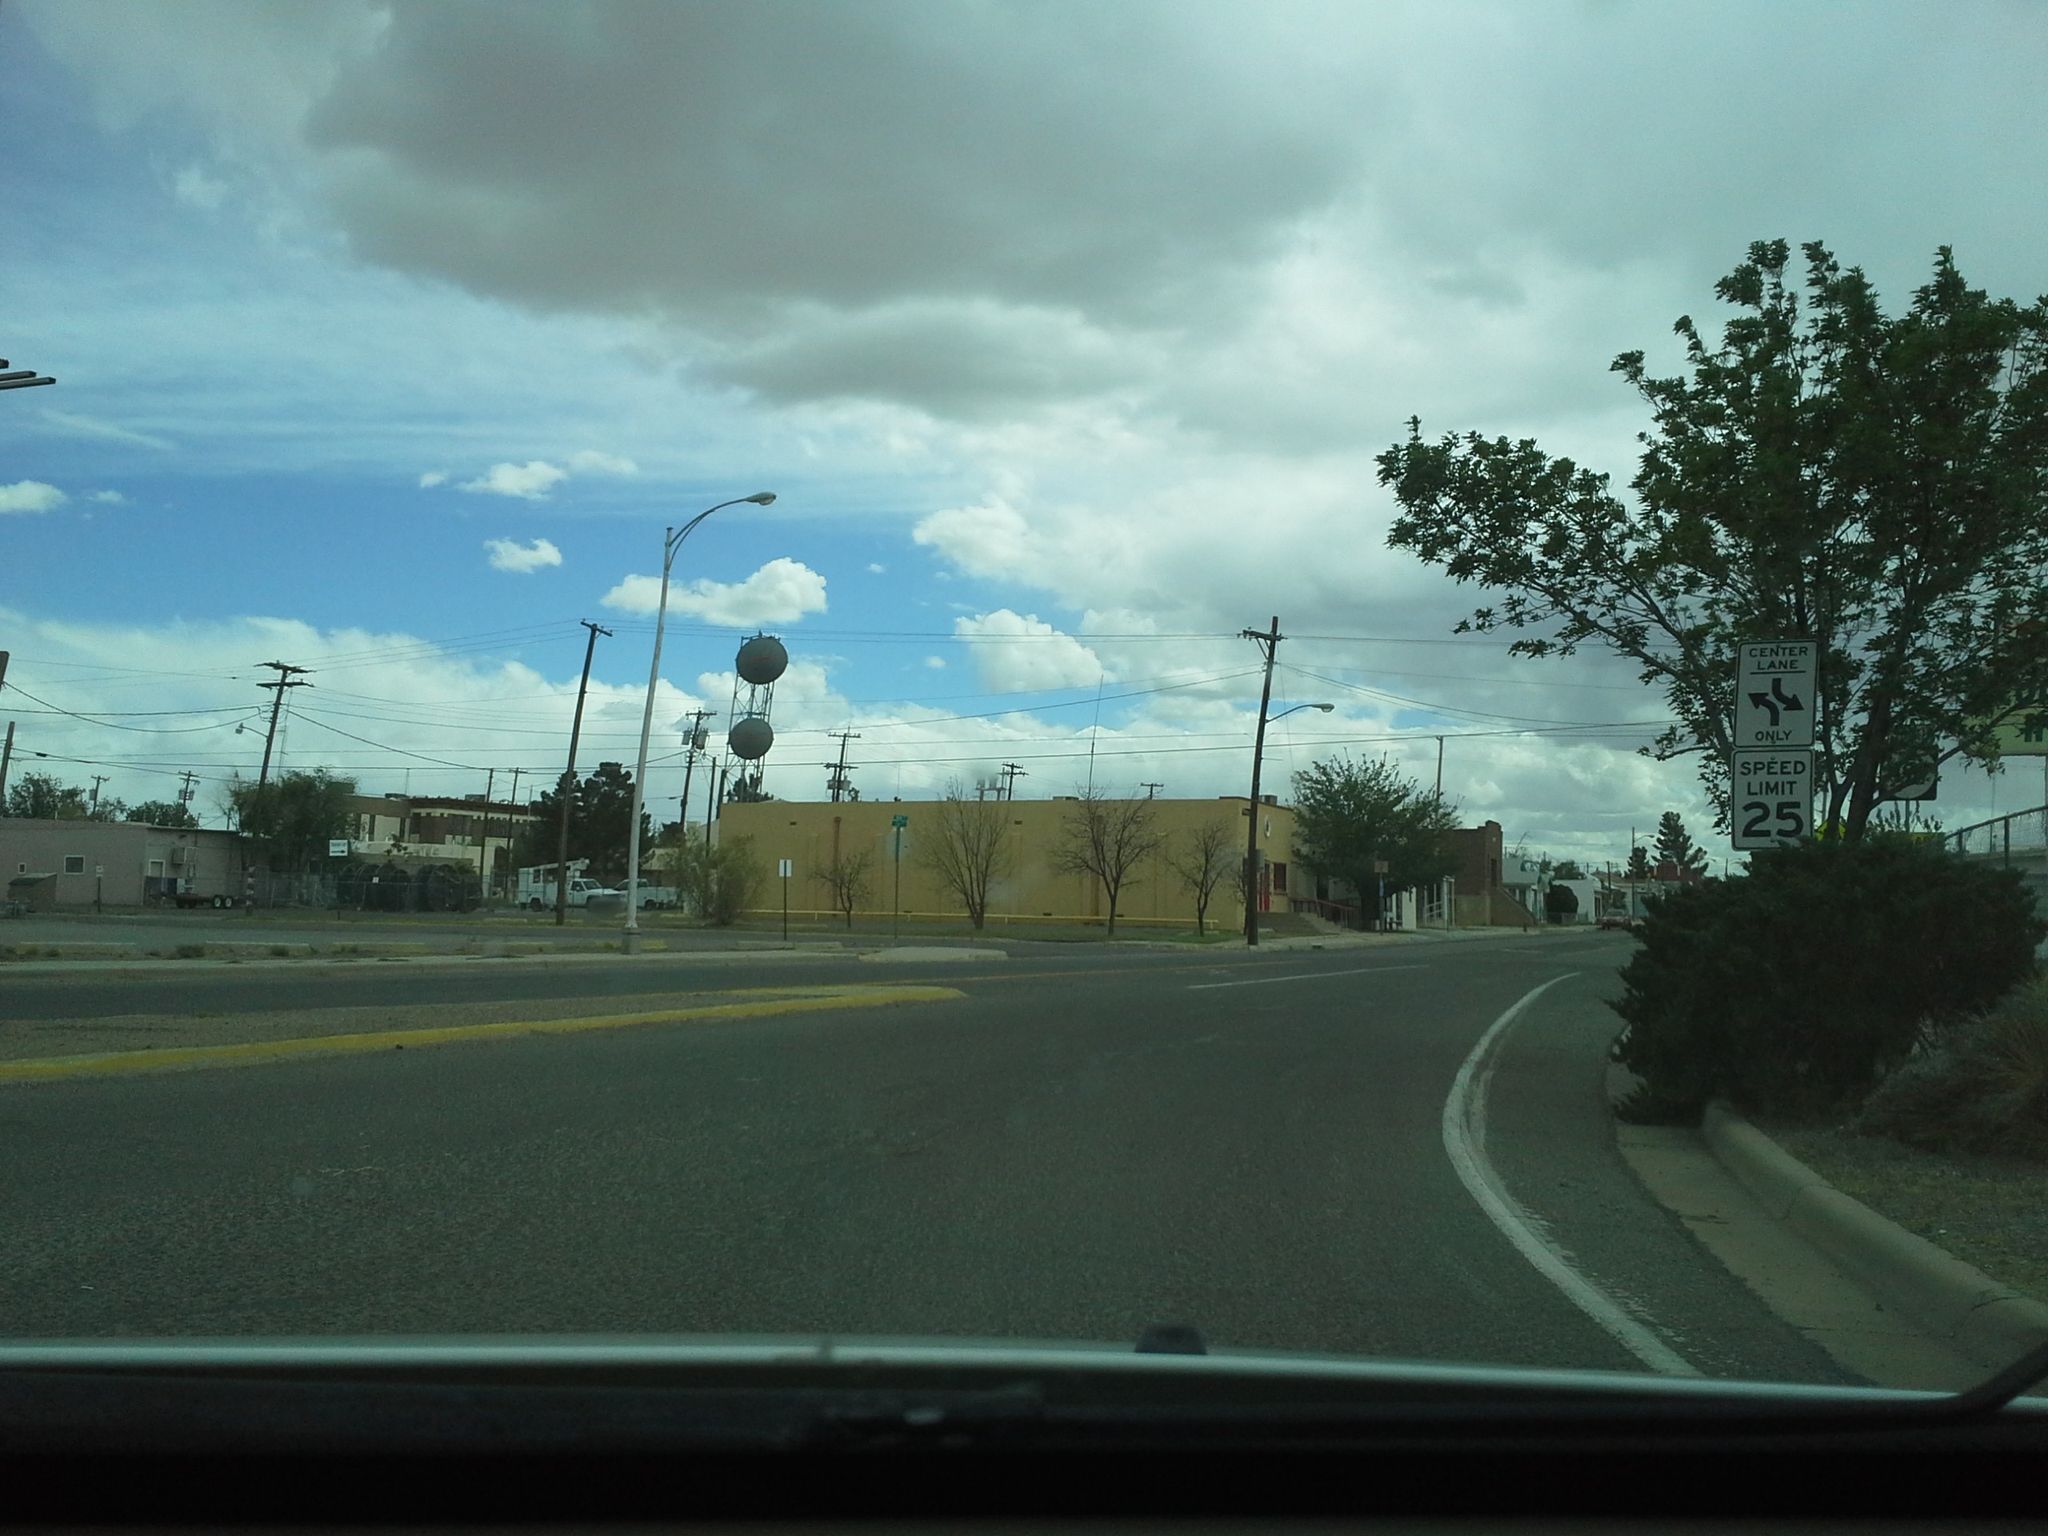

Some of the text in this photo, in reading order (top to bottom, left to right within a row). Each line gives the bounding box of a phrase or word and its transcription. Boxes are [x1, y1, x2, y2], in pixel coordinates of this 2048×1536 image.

[1749, 646, 1808, 658] CENTER
[1756, 660, 1798, 670] LANE
[1755, 731, 1792, 742] ONLY
[1740, 761, 1806, 776] SPEED
[1747, 781, 1797, 796] LIMIT
[1742, 801, 1804, 838] 25
